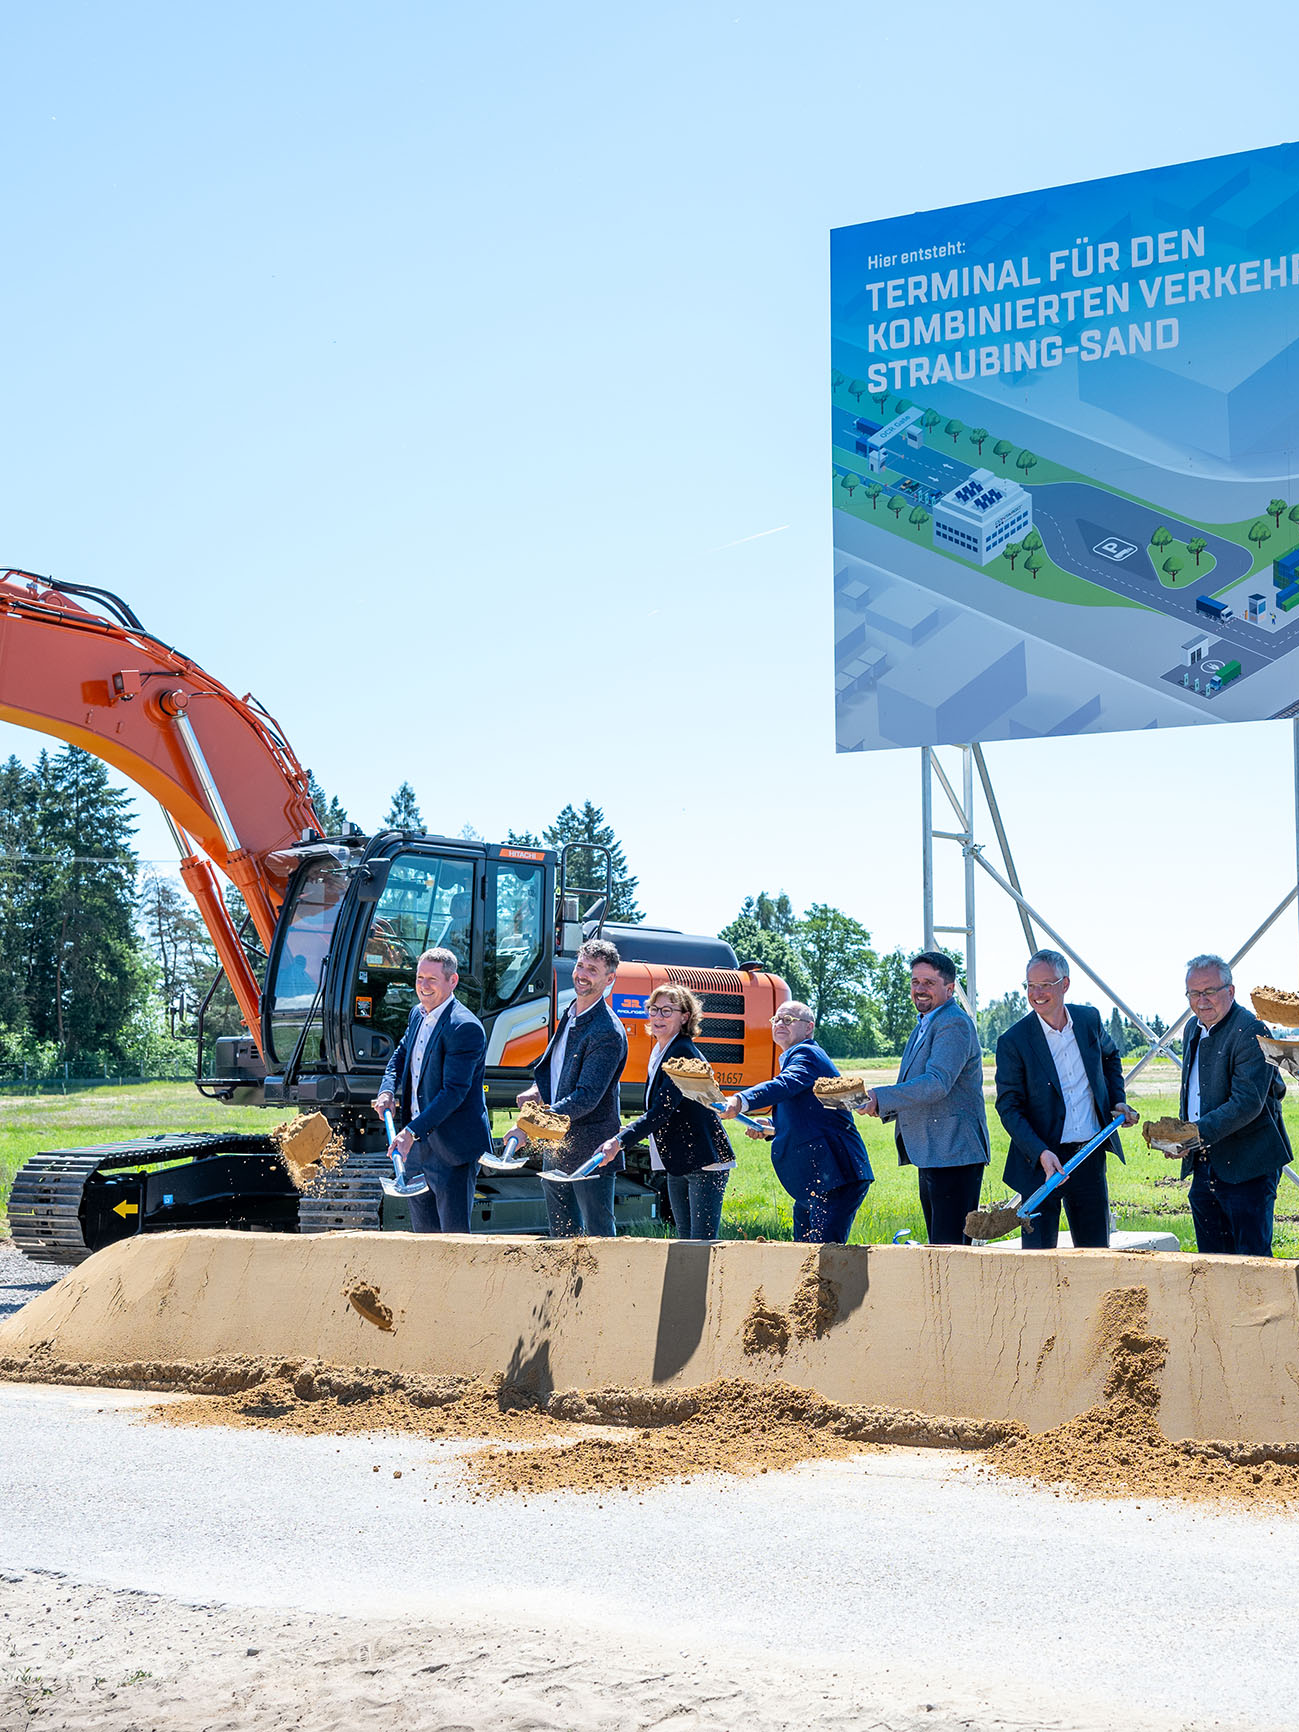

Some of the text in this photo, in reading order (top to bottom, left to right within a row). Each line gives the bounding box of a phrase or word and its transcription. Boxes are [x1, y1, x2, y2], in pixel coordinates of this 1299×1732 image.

[866, 226, 1205, 311] TERMINAL FÜR DEN
[868, 241, 965, 270] Hier entsteht:
[868, 282, 1129, 352] KOMBINIERTEN
[868, 317, 1179, 393] STRAUBING-SAND
[508, 850, 537, 859] HITACHI
